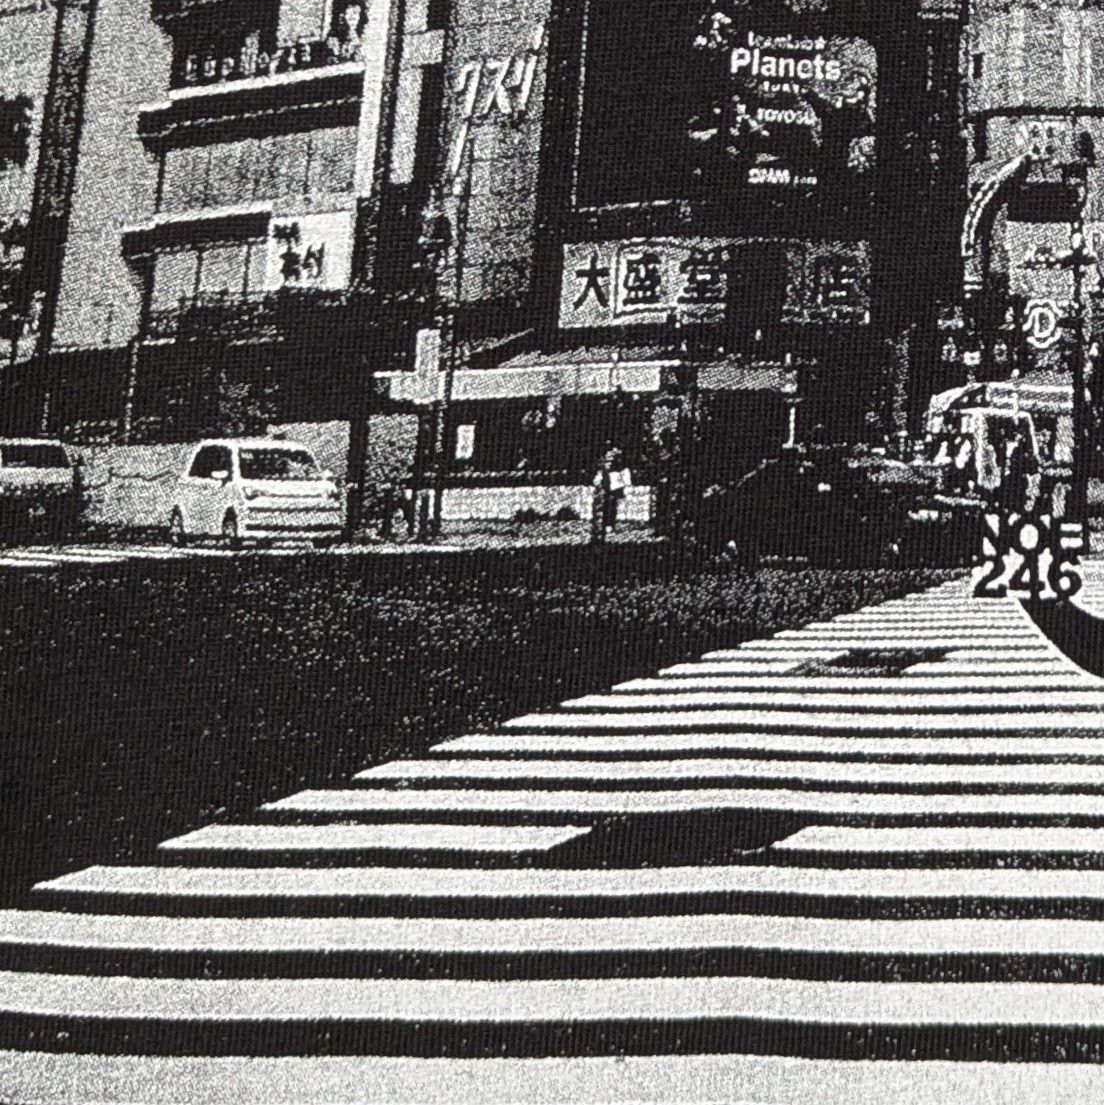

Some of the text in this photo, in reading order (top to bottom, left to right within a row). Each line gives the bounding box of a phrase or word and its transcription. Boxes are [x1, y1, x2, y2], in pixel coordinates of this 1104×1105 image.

[730, 47, 841, 80] Planets
[975, 513, 1085, 556] NOE
[972, 553, 1083, 598] 246
